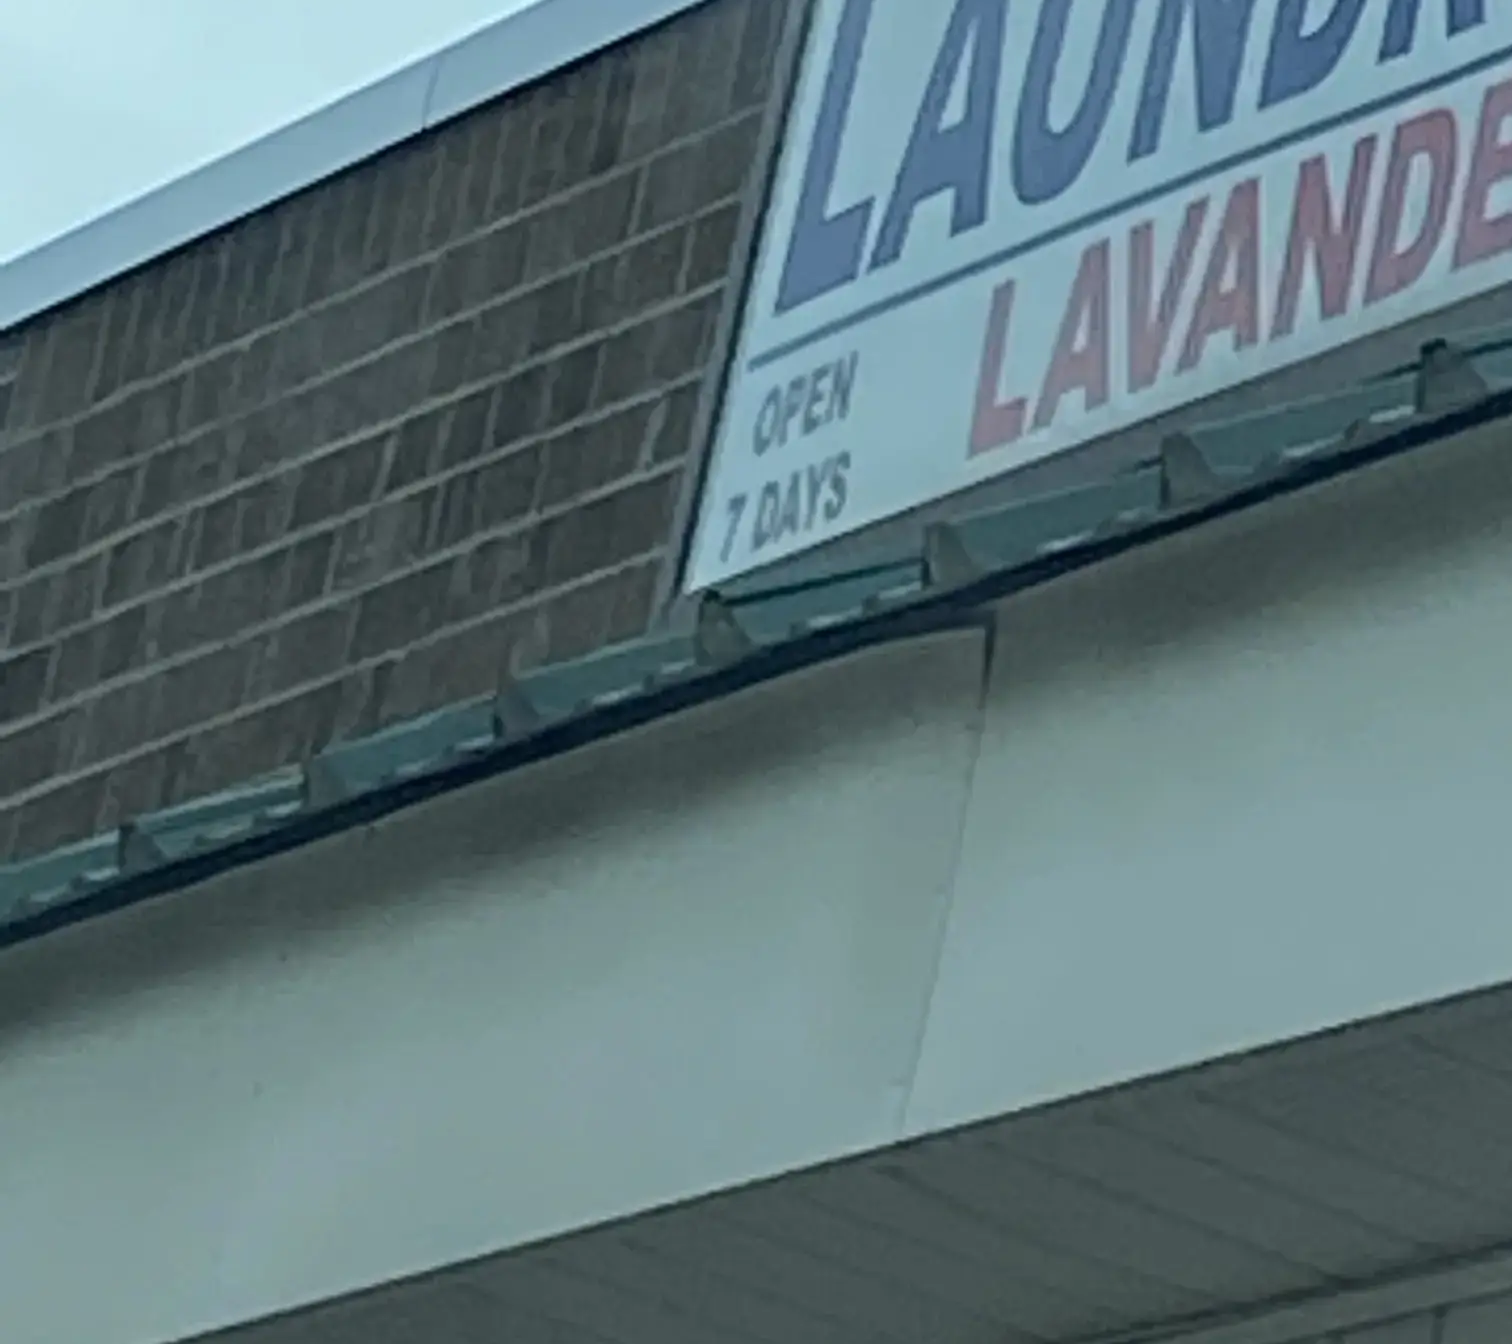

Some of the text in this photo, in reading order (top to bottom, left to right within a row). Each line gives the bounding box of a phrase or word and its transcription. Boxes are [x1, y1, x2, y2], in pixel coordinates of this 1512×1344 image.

[755, 351, 858, 456] OPEN
[720, 451, 850, 562] 7 DAYS
